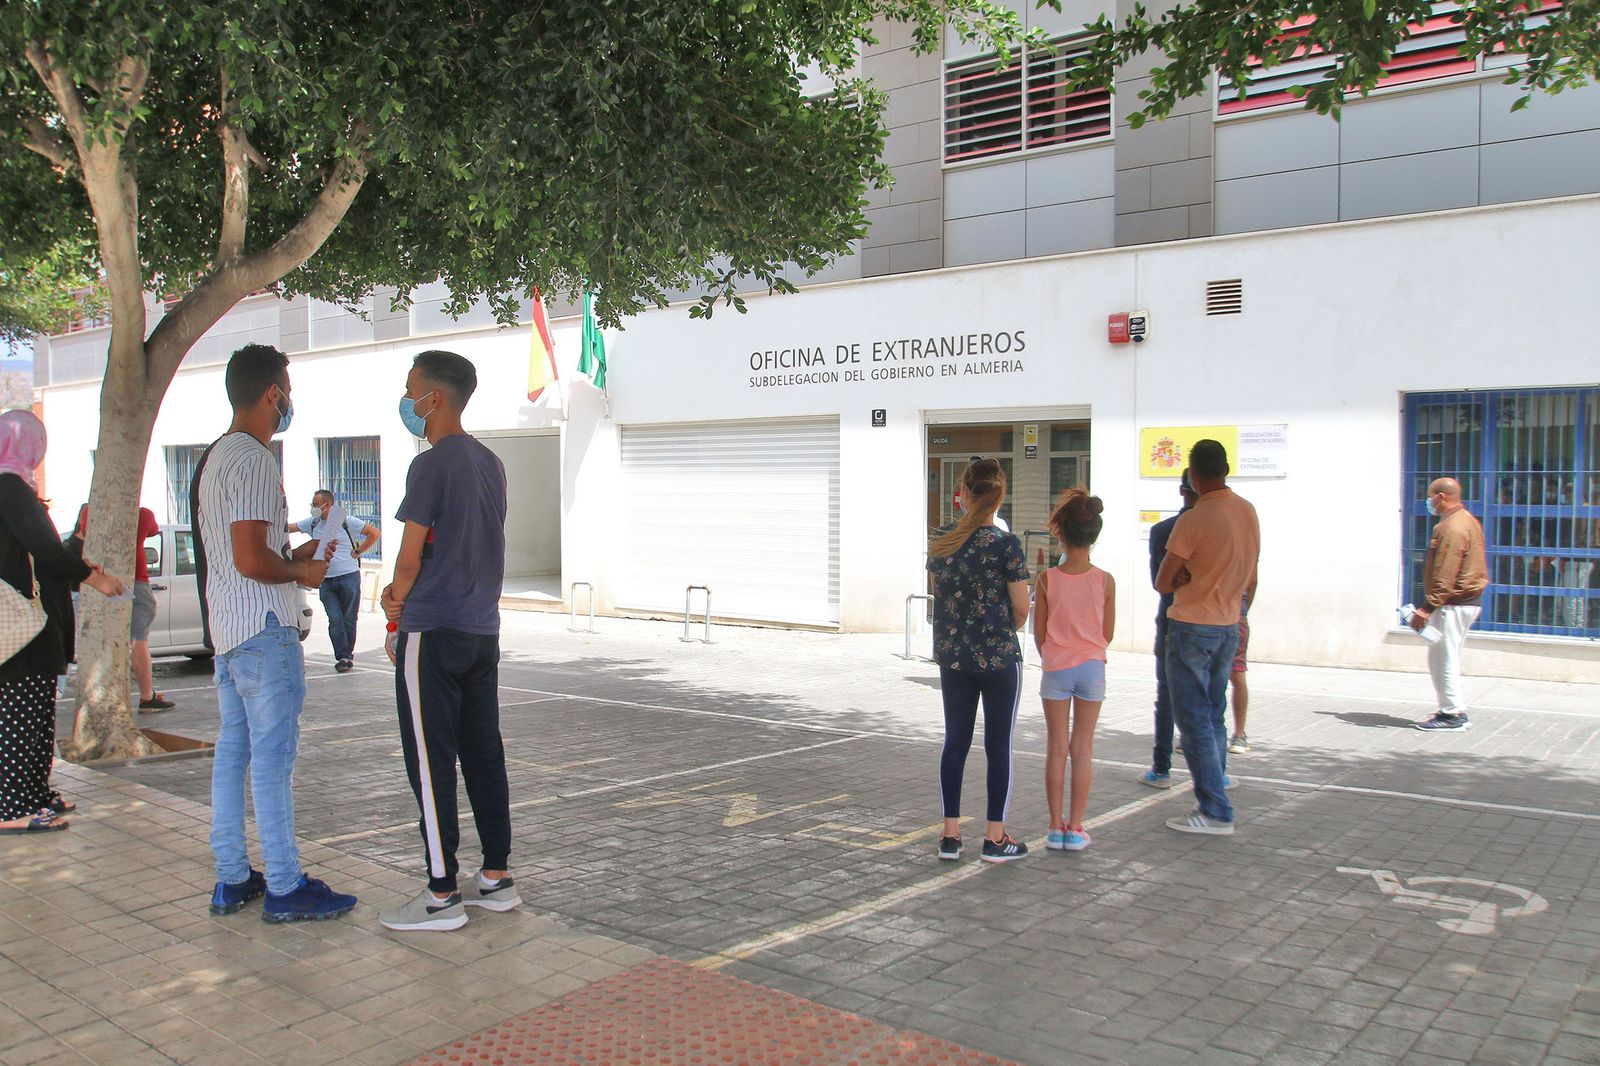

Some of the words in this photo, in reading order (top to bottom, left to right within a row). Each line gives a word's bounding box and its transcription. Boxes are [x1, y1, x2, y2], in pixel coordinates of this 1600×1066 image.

[750, 346, 826, 371] OFICINA
[836, 343, 861, 365] DE
[872, 330, 1026, 362] EXTRANJEROS
[749, 371, 839, 388] SUBDELEGACION
[844, 369, 865, 382] DEL
[871, 365, 935, 381] GOBIERNO
[941, 363, 957, 377] EN
[963, 359, 1024, 375] ALMERIA
